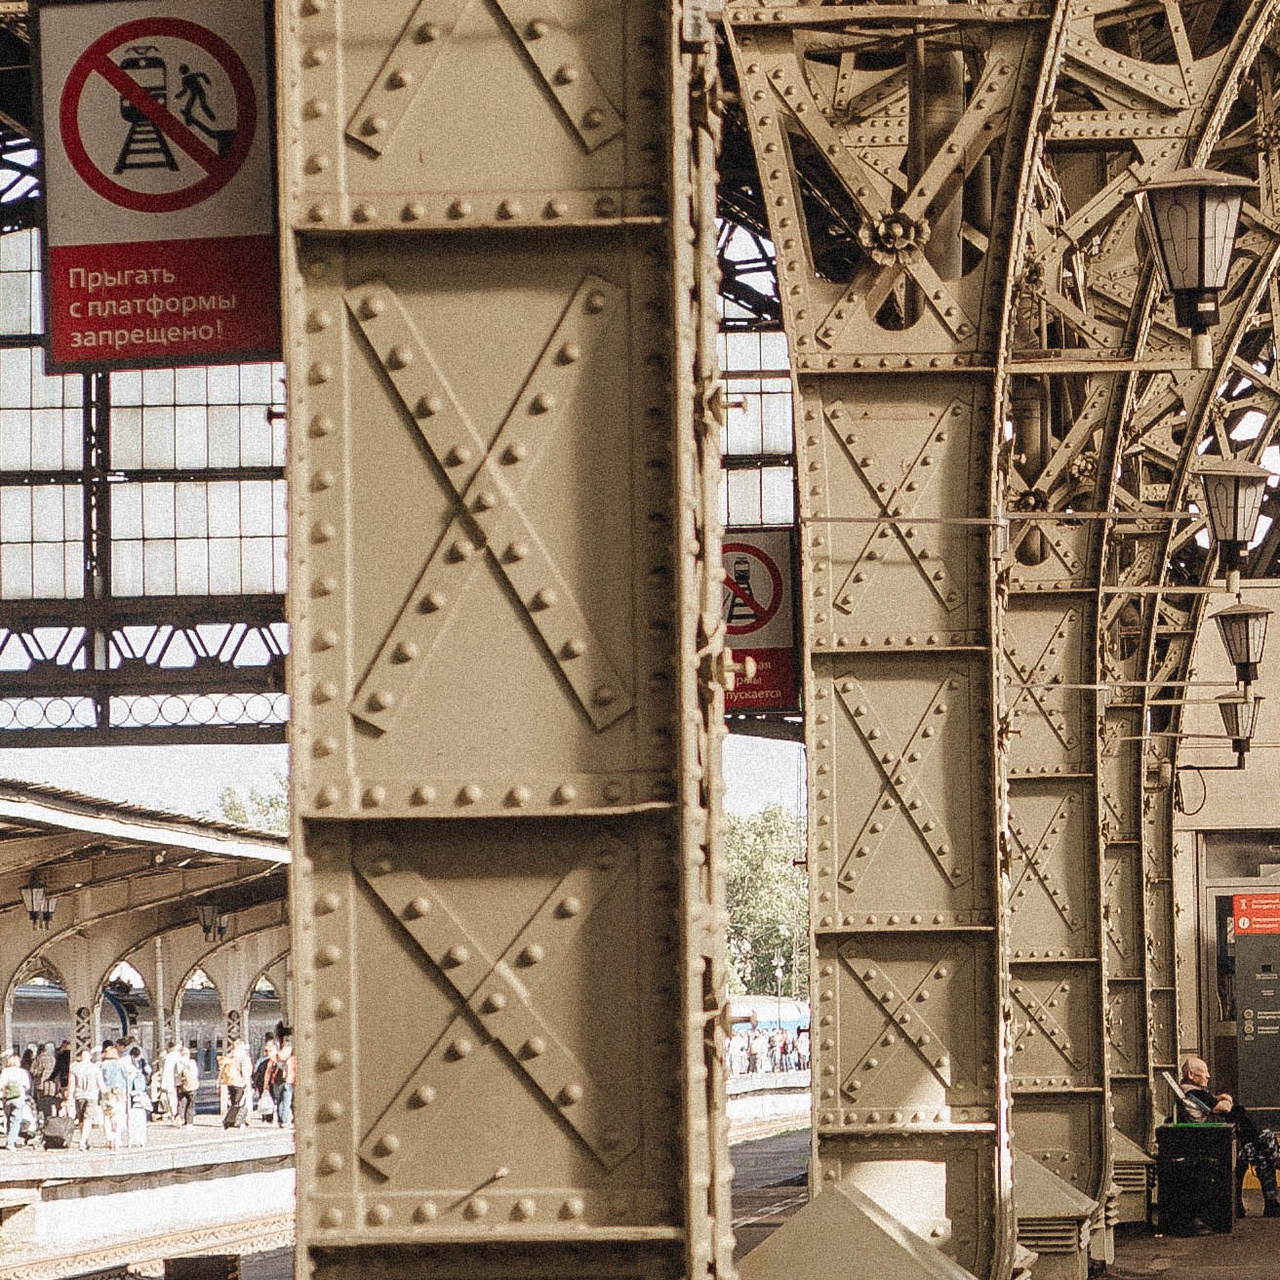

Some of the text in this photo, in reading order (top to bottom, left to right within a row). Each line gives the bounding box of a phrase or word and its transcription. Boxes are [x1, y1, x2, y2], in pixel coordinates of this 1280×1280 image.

[68, 268, 176, 292] Прыгать
[69, 293, 235, 318] с платформы
[70, 320, 222, 350] запрещено!
[726, 690, 782, 702] пускается
